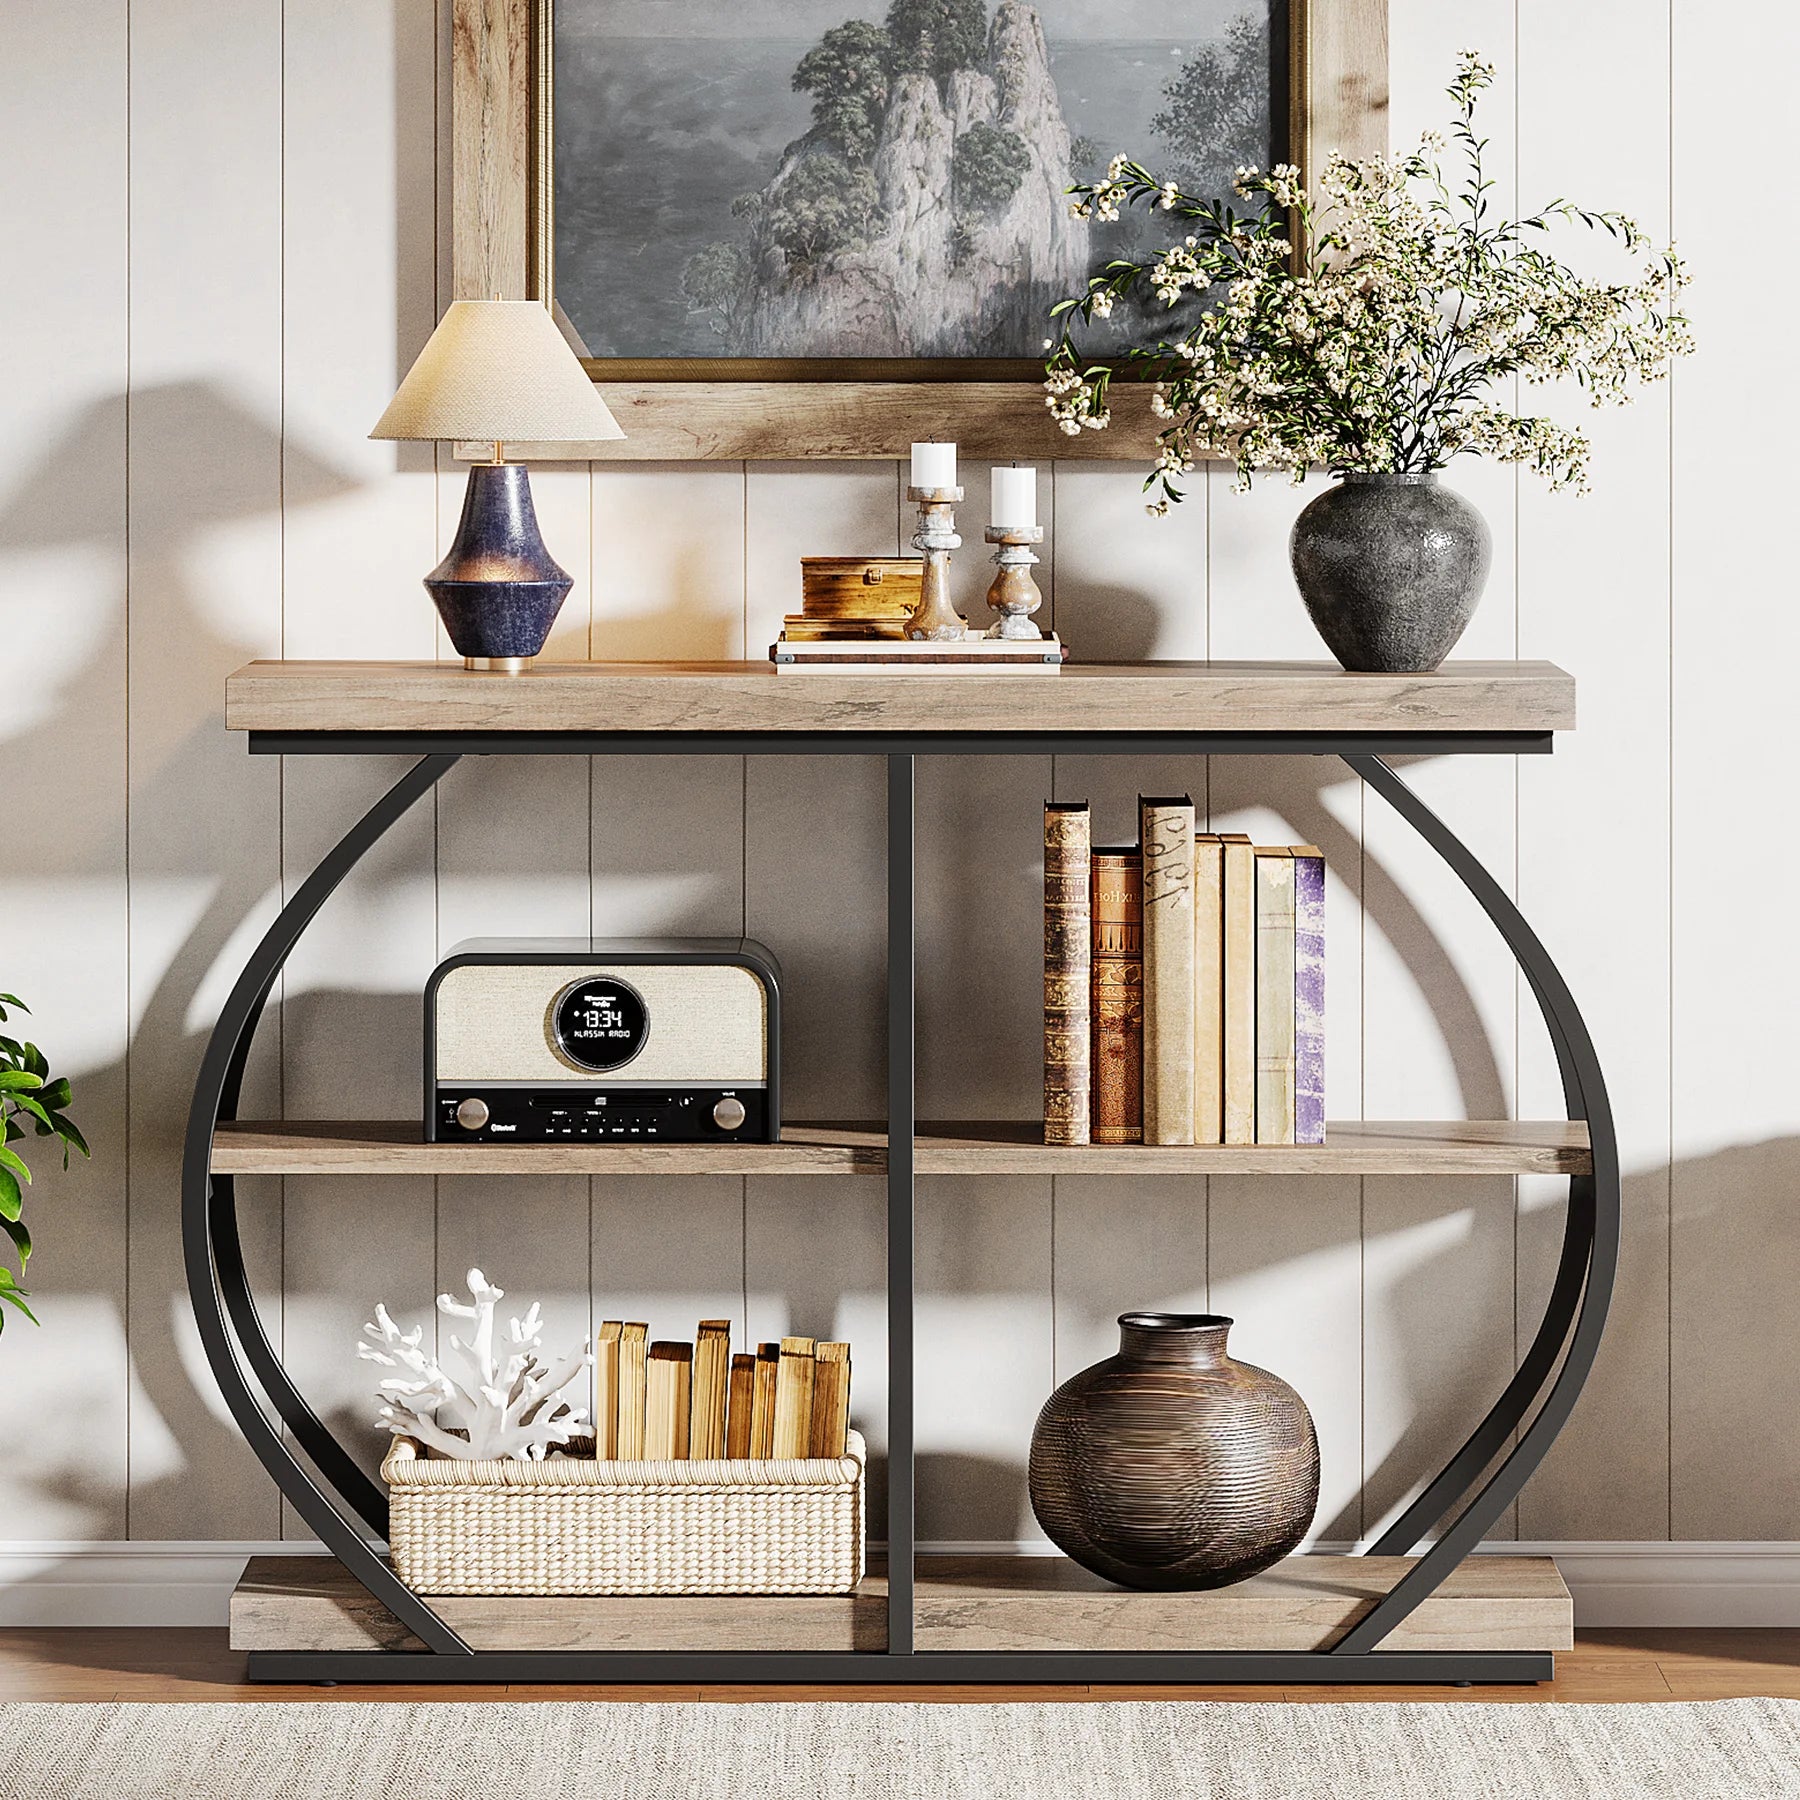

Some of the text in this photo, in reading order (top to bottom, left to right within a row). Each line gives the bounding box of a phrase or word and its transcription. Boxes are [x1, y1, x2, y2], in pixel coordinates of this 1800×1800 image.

[583, 1010, 622, 1028] 13:34
[574, 1029, 631, 1039] KLASSIK RADIO
